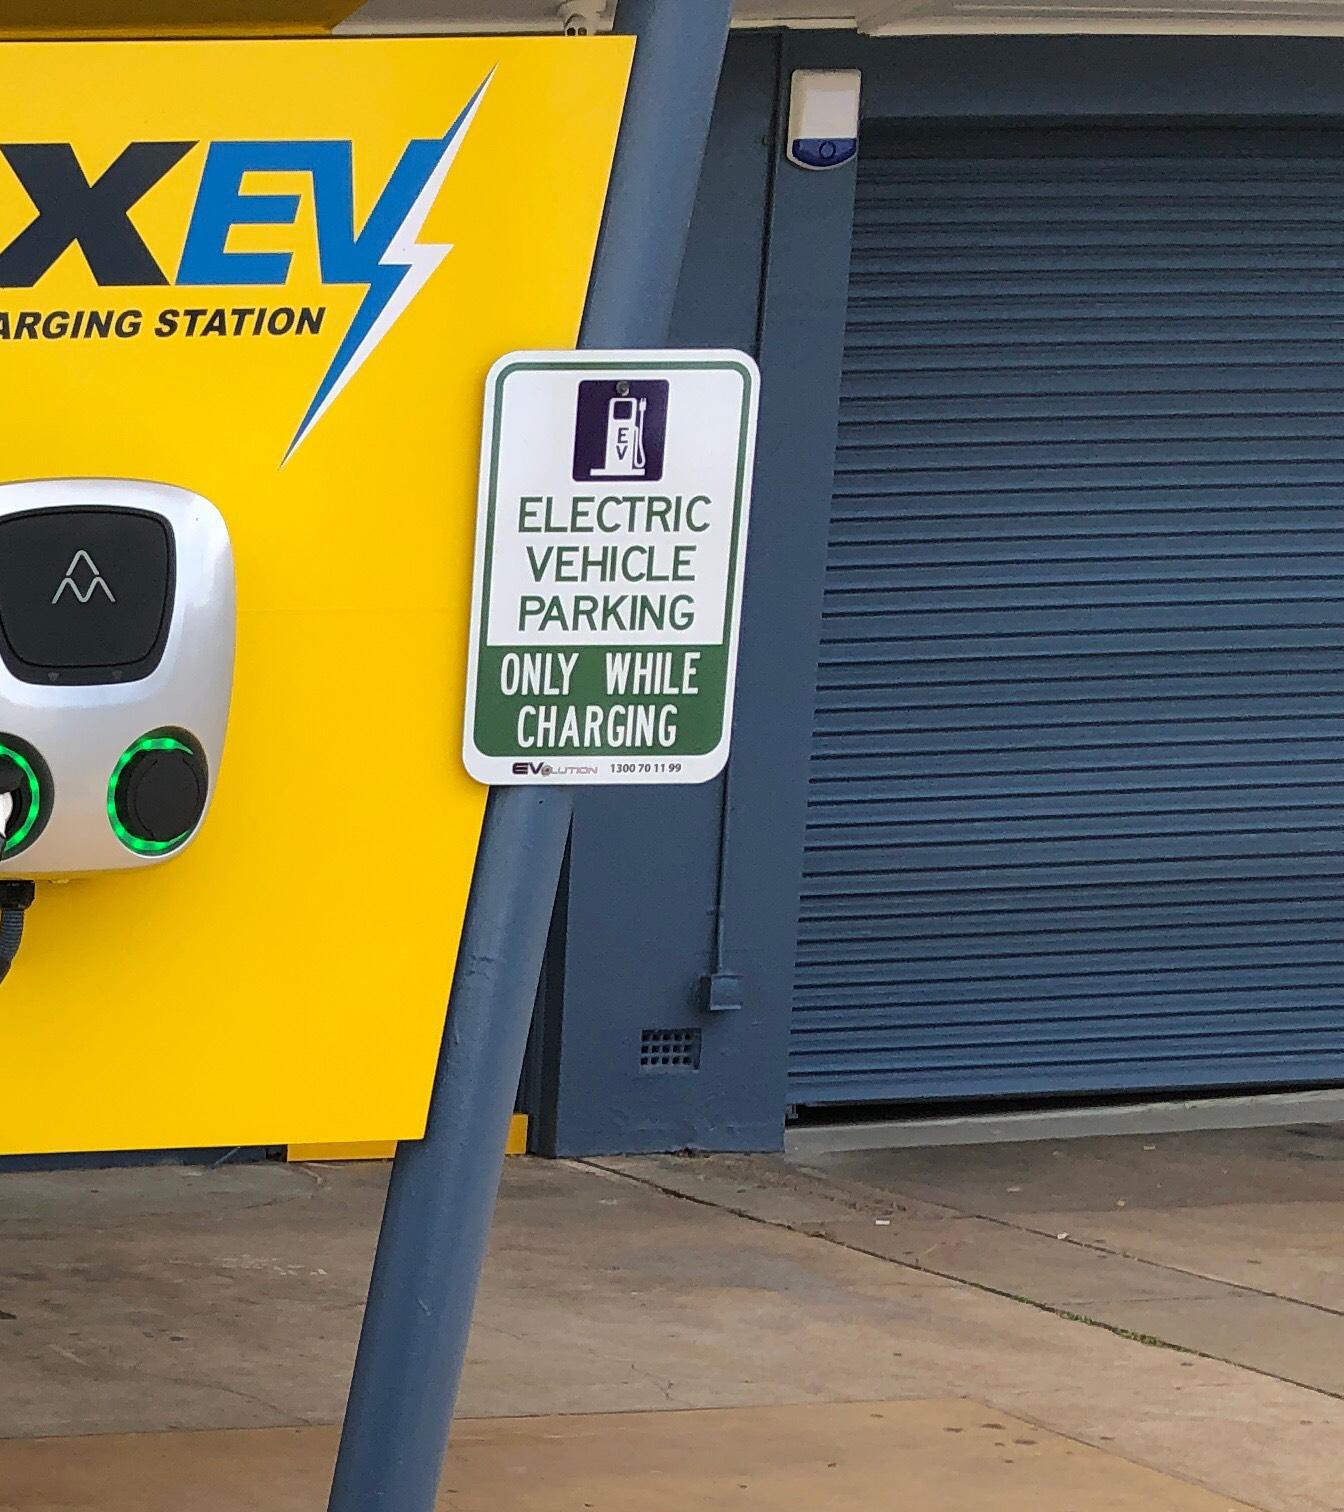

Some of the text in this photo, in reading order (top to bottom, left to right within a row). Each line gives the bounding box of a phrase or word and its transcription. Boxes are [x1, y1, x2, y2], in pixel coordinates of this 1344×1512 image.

[154, 306, 326, 339] STATION
[517, 495, 712, 534] ELECTRIC
[525, 545, 697, 583] VEHICLE
[518, 594, 696, 632] PARKING
[499, 651, 700, 696] ONLY WHILE
[516, 703, 677, 748] CHARGING
[610, 763, 636, 774] 1300
[638, 763, 651, 773] 70
[654, 763, 666, 773] 11
[668, 762, 682, 773] 99
